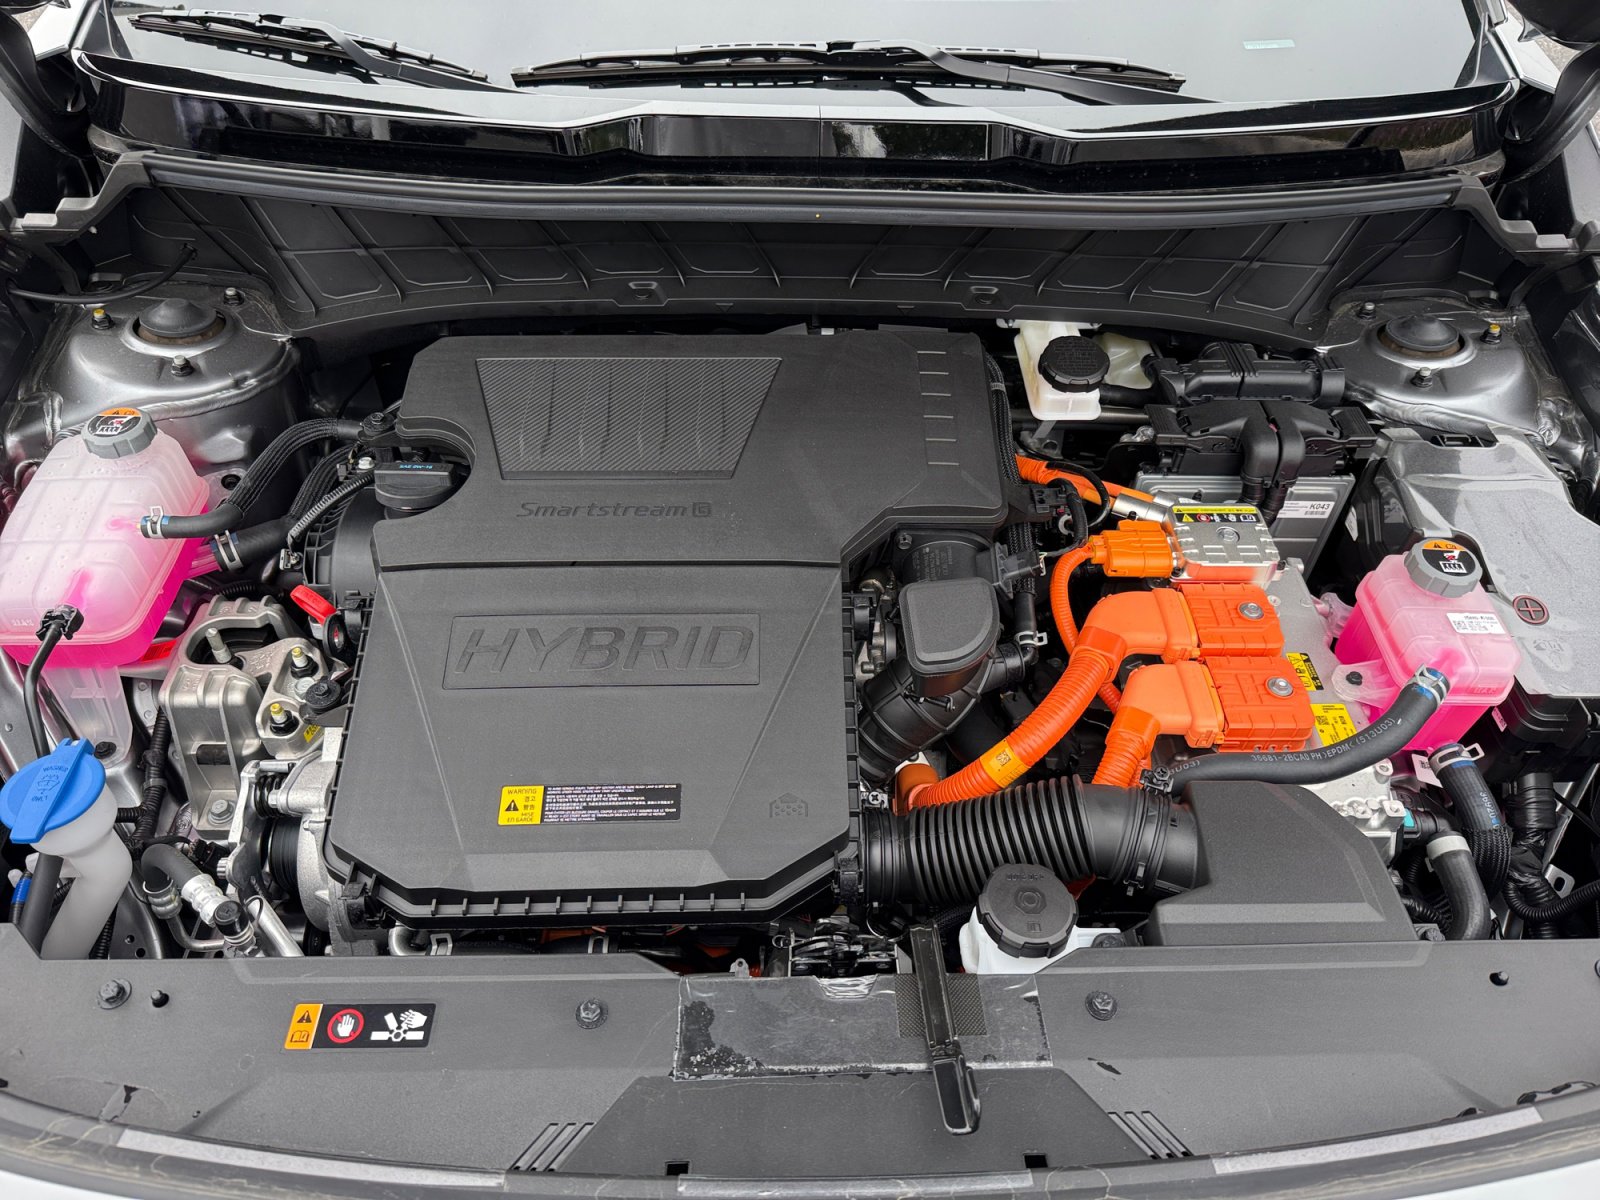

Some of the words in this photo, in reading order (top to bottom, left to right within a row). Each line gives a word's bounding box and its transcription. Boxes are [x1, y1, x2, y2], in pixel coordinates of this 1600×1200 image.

[516, 502, 687, 518] Smartstream
[1309, 503, 1331, 511] K043
[454, 625, 755, 674] HYBRID
